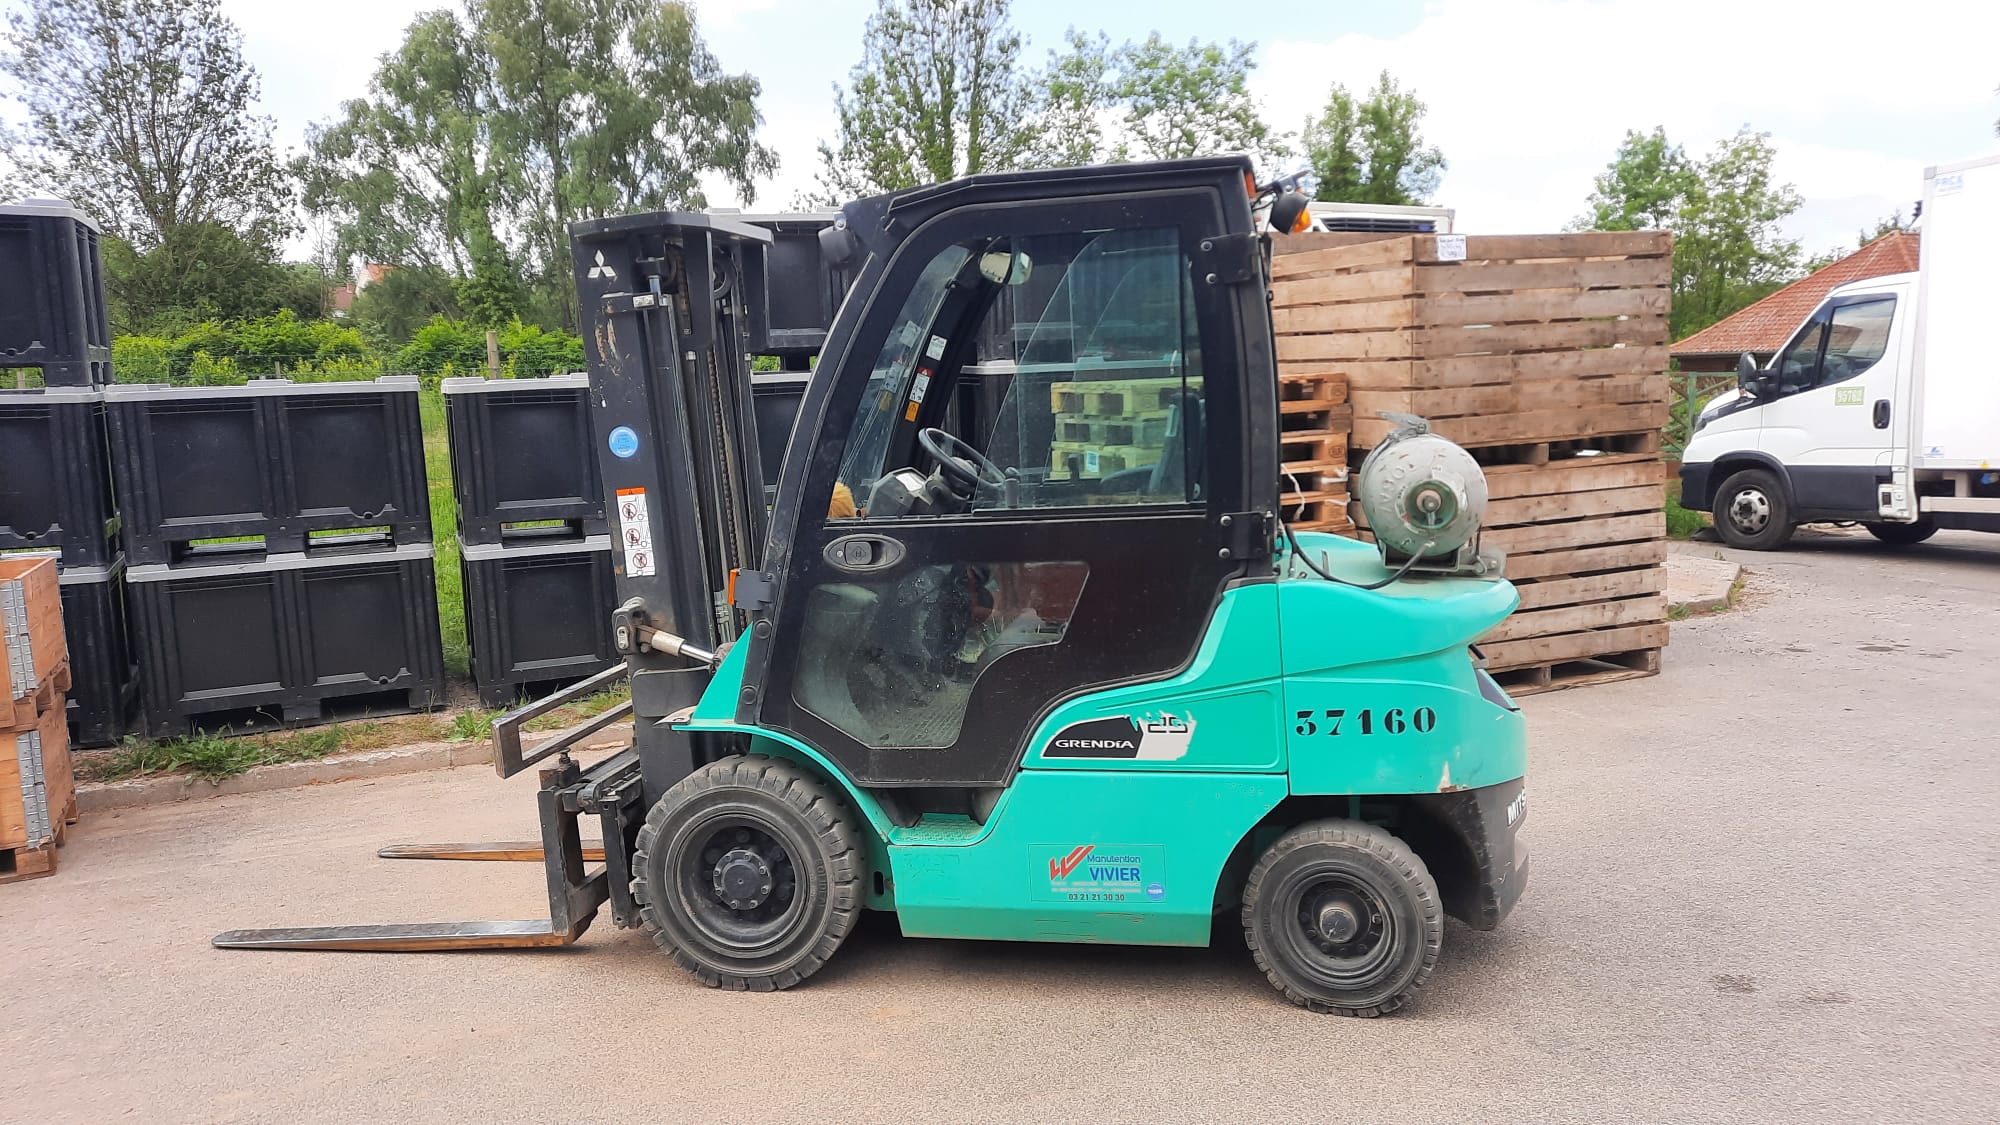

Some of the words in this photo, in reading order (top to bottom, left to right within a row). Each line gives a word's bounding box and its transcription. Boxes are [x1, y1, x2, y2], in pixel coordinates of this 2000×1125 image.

[1295, 706, 1437, 736] 37160
[1087, 854, 1141, 863] Manutention
[1089, 867, 1141, 881] VIVIER
[1068, 893, 1078, 901] 03
[1080, 893, 1089, 901] 21
[1092, 893, 1100, 901] 21
[1104, 893, 1113, 901] 30
